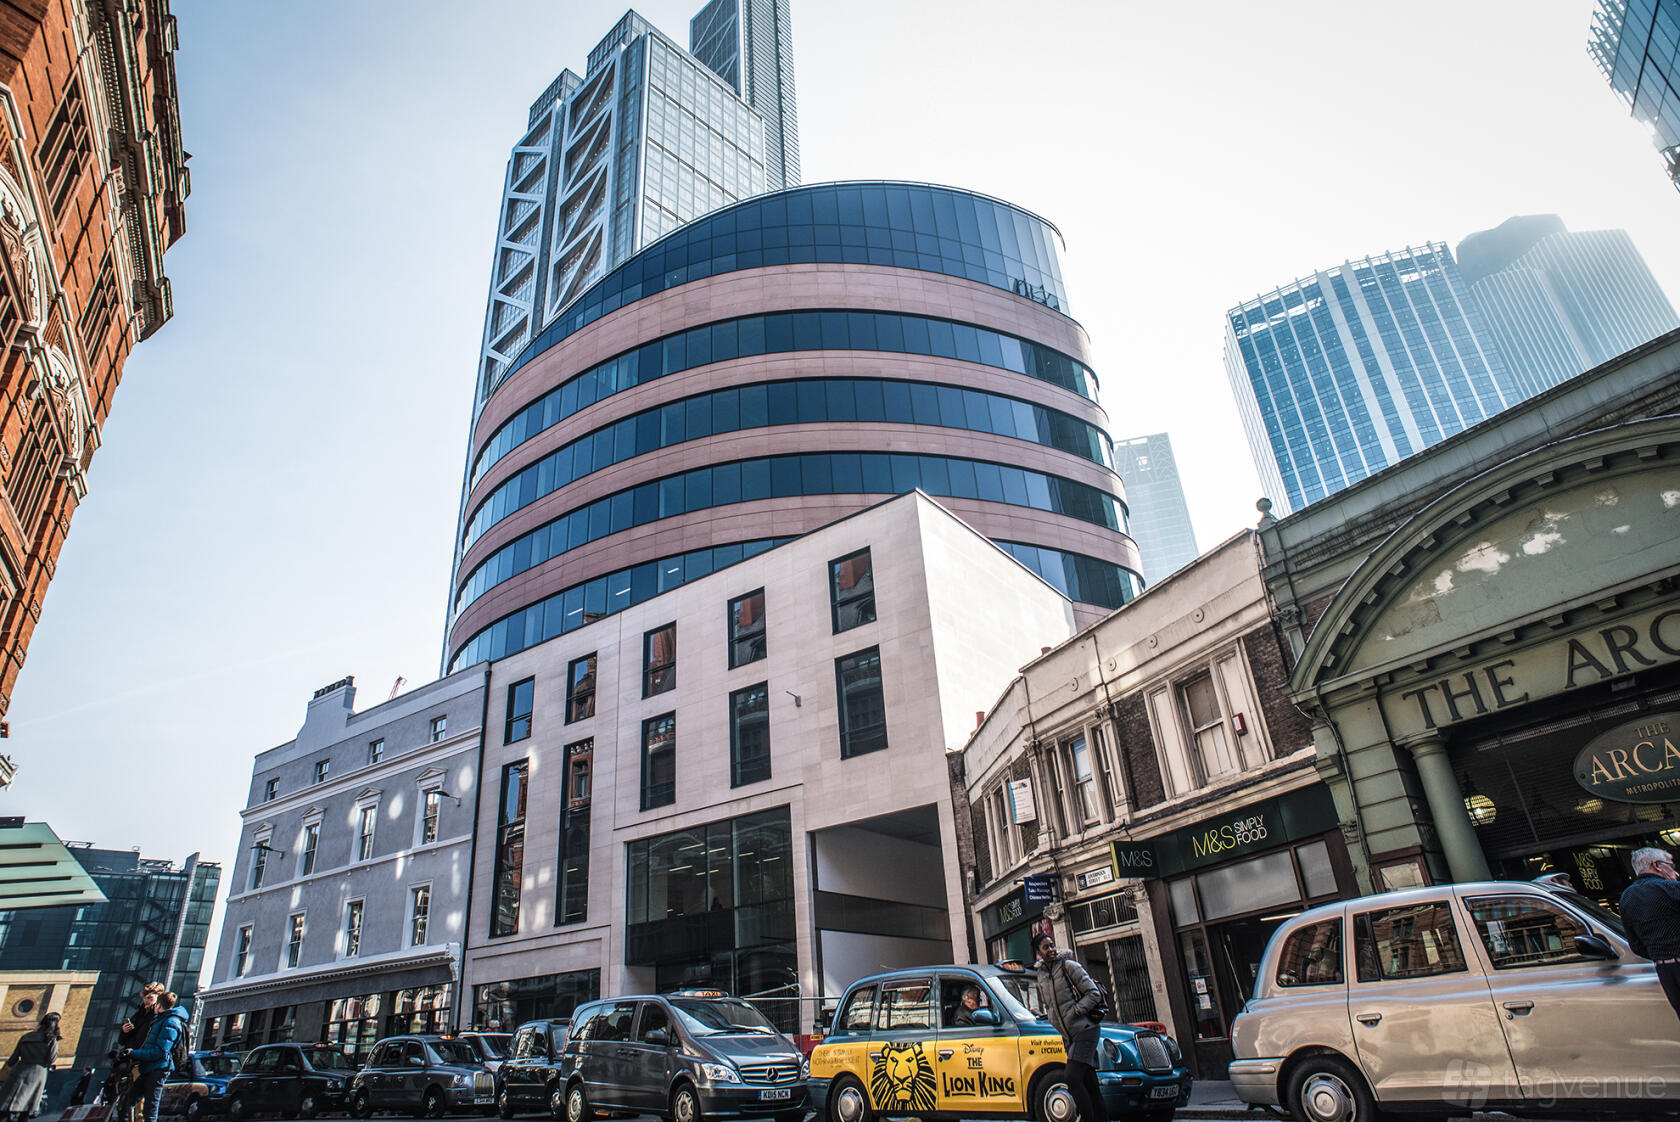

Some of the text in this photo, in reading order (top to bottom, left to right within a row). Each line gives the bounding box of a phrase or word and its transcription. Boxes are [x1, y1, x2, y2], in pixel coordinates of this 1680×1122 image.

[1402, 659, 1529, 729] THE
[1634, 720, 1671, 739] THE
[1233, 814, 1264, 834] SIMPLY
[1192, 825, 1236, 858] M&S
[1236, 827, 1268, 846] FOOD
[1120, 850, 1153, 868] M&S
[1583, 878, 1604, 890] FOOD
[967, 1057, 983, 1067] THE
[942, 1071, 1016, 1098] LION KING
